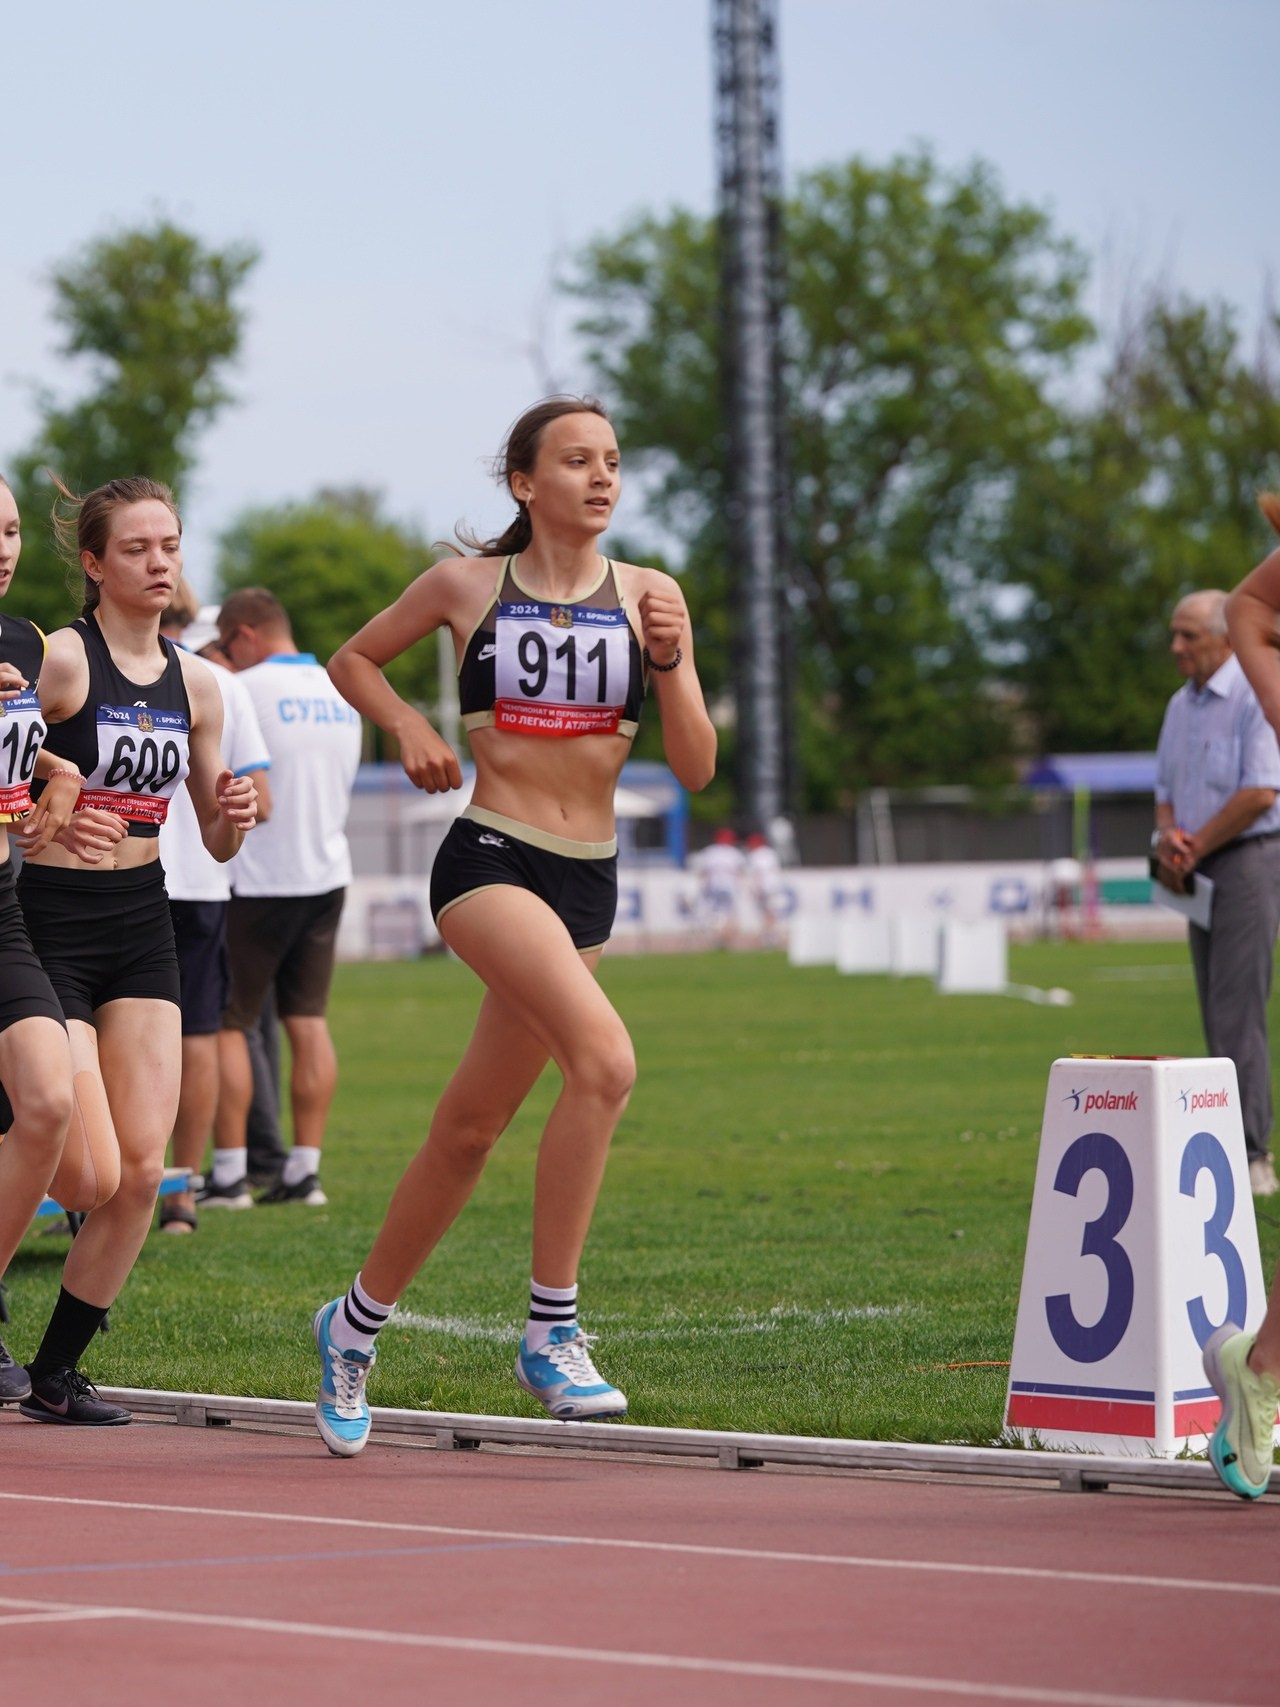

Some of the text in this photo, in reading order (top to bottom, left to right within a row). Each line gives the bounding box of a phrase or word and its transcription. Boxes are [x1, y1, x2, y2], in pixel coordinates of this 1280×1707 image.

[509, 605, 540, 614] 2024
[586, 612, 617, 622] БРЯНСК
[518, 631, 606, 703] 911
[106, 710, 130, 720] 2024
[501, 713, 517, 723] ПО
[518, 715, 563, 729] ЛЕГКОЙ
[104, 735, 180, 794] 609
[1084, 1089, 1138, 1113] polanik
[1191, 1088, 1229, 1114] polanik
[1045, 1132, 1134, 1364] 3
[1179, 1131, 1248, 1353] 3
